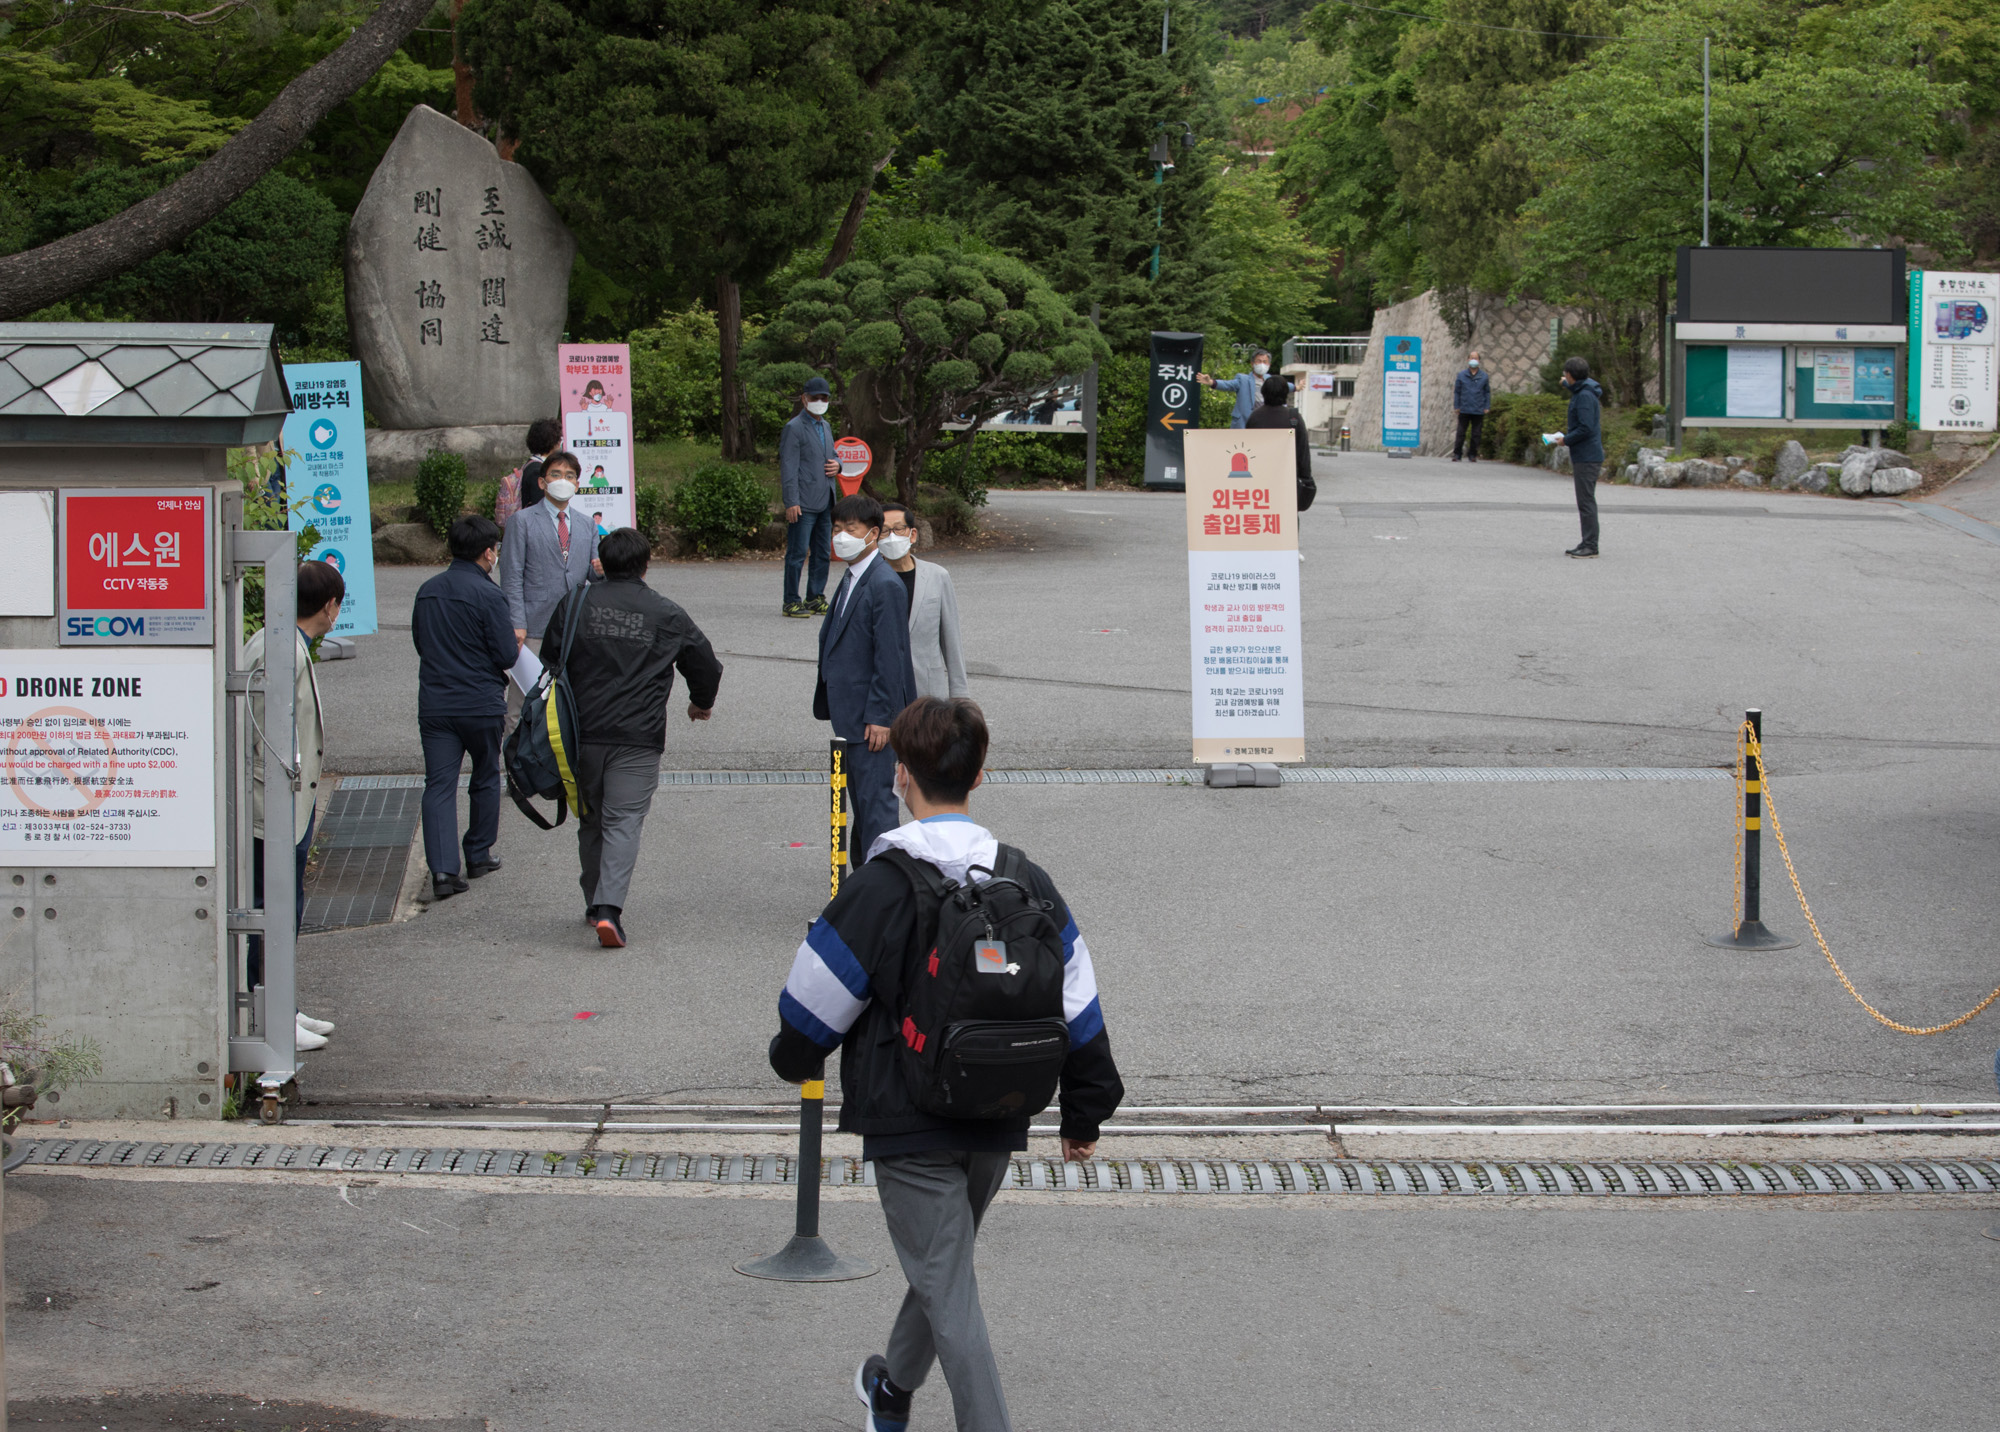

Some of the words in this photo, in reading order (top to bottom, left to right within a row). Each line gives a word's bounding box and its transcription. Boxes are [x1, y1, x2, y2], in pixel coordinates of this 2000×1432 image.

[413, 186, 448, 252] 剛健
[476, 186, 512, 251] 至誠
[1938, 279, 1986, 290] 종합안내도
[414, 279, 446, 346] 協同
[568, 355, 594, 363] 코로나19
[596, 355, 620, 363] 감염예방
[565, 365, 589, 375] 학부모
[592, 364, 624, 375] 협조사항
[1396, 362, 1411, 370] 안내
[1157, 363, 1194, 382] 주차
[295, 379, 325, 390] 코로나19
[326, 379, 347, 389] 감염증
[294, 391, 350, 410] 예방수칙
[1170, 388, 1181, 403] P
[305, 451, 328, 462] 마스크
[329, 450, 344, 461] 착용
[837, 450, 866, 460] 주차금지
[307, 463, 326, 472] 교내에서
[327, 462, 344, 471] 마스크
[580, 487, 597, 495] 37.5도
[599, 487, 610, 495] 이상
[1212, 488, 1270, 511] 외부인
[157, 500, 183, 511] 언제나
[184, 499, 201, 511] 안심
[306, 516, 328, 527] 손씻기
[329, 515, 352, 526] 생활화
[1202, 513, 1281, 536] 출입통제
[88, 531, 181, 569] 에스원
[1242, 572, 1276, 580] 바이러스의
[103, 577, 135, 591] CCTV
[136, 576, 169, 592] 작동중
[1207, 583, 1221, 591] 교내
[1222, 583, 1236, 591] 확산
[1238, 583, 1258, 591] 방지를
[1260, 583, 1281, 591] 위하여
[1204, 604, 1225, 612] 학생과
[1242, 614, 1262, 622] 출입을
[67, 616, 144, 637] SECOM
[335, 622, 355, 630] 고등학교
[1204, 625, 1225, 633] 엄격히
[1227, 625, 1254, 633] 금지하고
[1209, 646, 1223, 654] 급한
[1225, 646, 1246, 654] 용무가
[1203, 656, 1217, 664] 정문
[1219, 656, 1273, 664] 배움터지킴이실을
[1275, 656, 1289, 664] 통해
[1205, 667, 1226, 675] 안내를
[1228, 667, 1255, 675] 받으시길
[16, 677, 84, 698] DRONE
[91, 677, 142, 698] ZONE
[1210, 688, 1224, 696] 저희
[1215, 709, 1236, 717] 최선을
[1237, 709, 1280, 717] 다하겠습니다.
[26, 718, 43, 727] 승인
[45, 718, 61, 727] 없이
[63, 718, 87, 727] 임의로
[89, 718, 106, 727] 비행
[107, 718, 132, 727] 시에는
[0, 731, 15, 740] 최대
[17, 731, 47, 740] 200만원
[49, 731, 73, 740] 이하의
[76, 731, 92, 740] 벌금
[94, 731, 110, 740] 또는
[112, 731, 144, 740] 과태료가
[146, 730, 189, 740] 부과됩니다.
[29, 747, 66, 758] approval
[67, 747, 76, 756] of
[77, 747, 109, 756] Related
[1234, 747, 1274, 755] 경복고등학교
[8, 760, 34, 769] would
[35, 760, 46, 769] be
[47, 760, 81, 771] charged
[83, 760, 101, 769] with
[109, 760, 126, 769] fine
[127, 761, 146, 771] upto
[148, 760, 178, 770] $2,000.
[20, 809, 50, 818] 조종하는
[52, 809, 76, 818] 사람을
[77, 809, 100, 818] 보시면
[102, 809, 126, 818] 신고해
[127, 809, 160, 818] 주십시오.
[2, 823, 17, 831] 신고
[24, 823, 70, 832] 제3033부대
[73, 823, 131, 832] (02-524-3733)
[73, 833, 131, 842] (02-722-6500)
